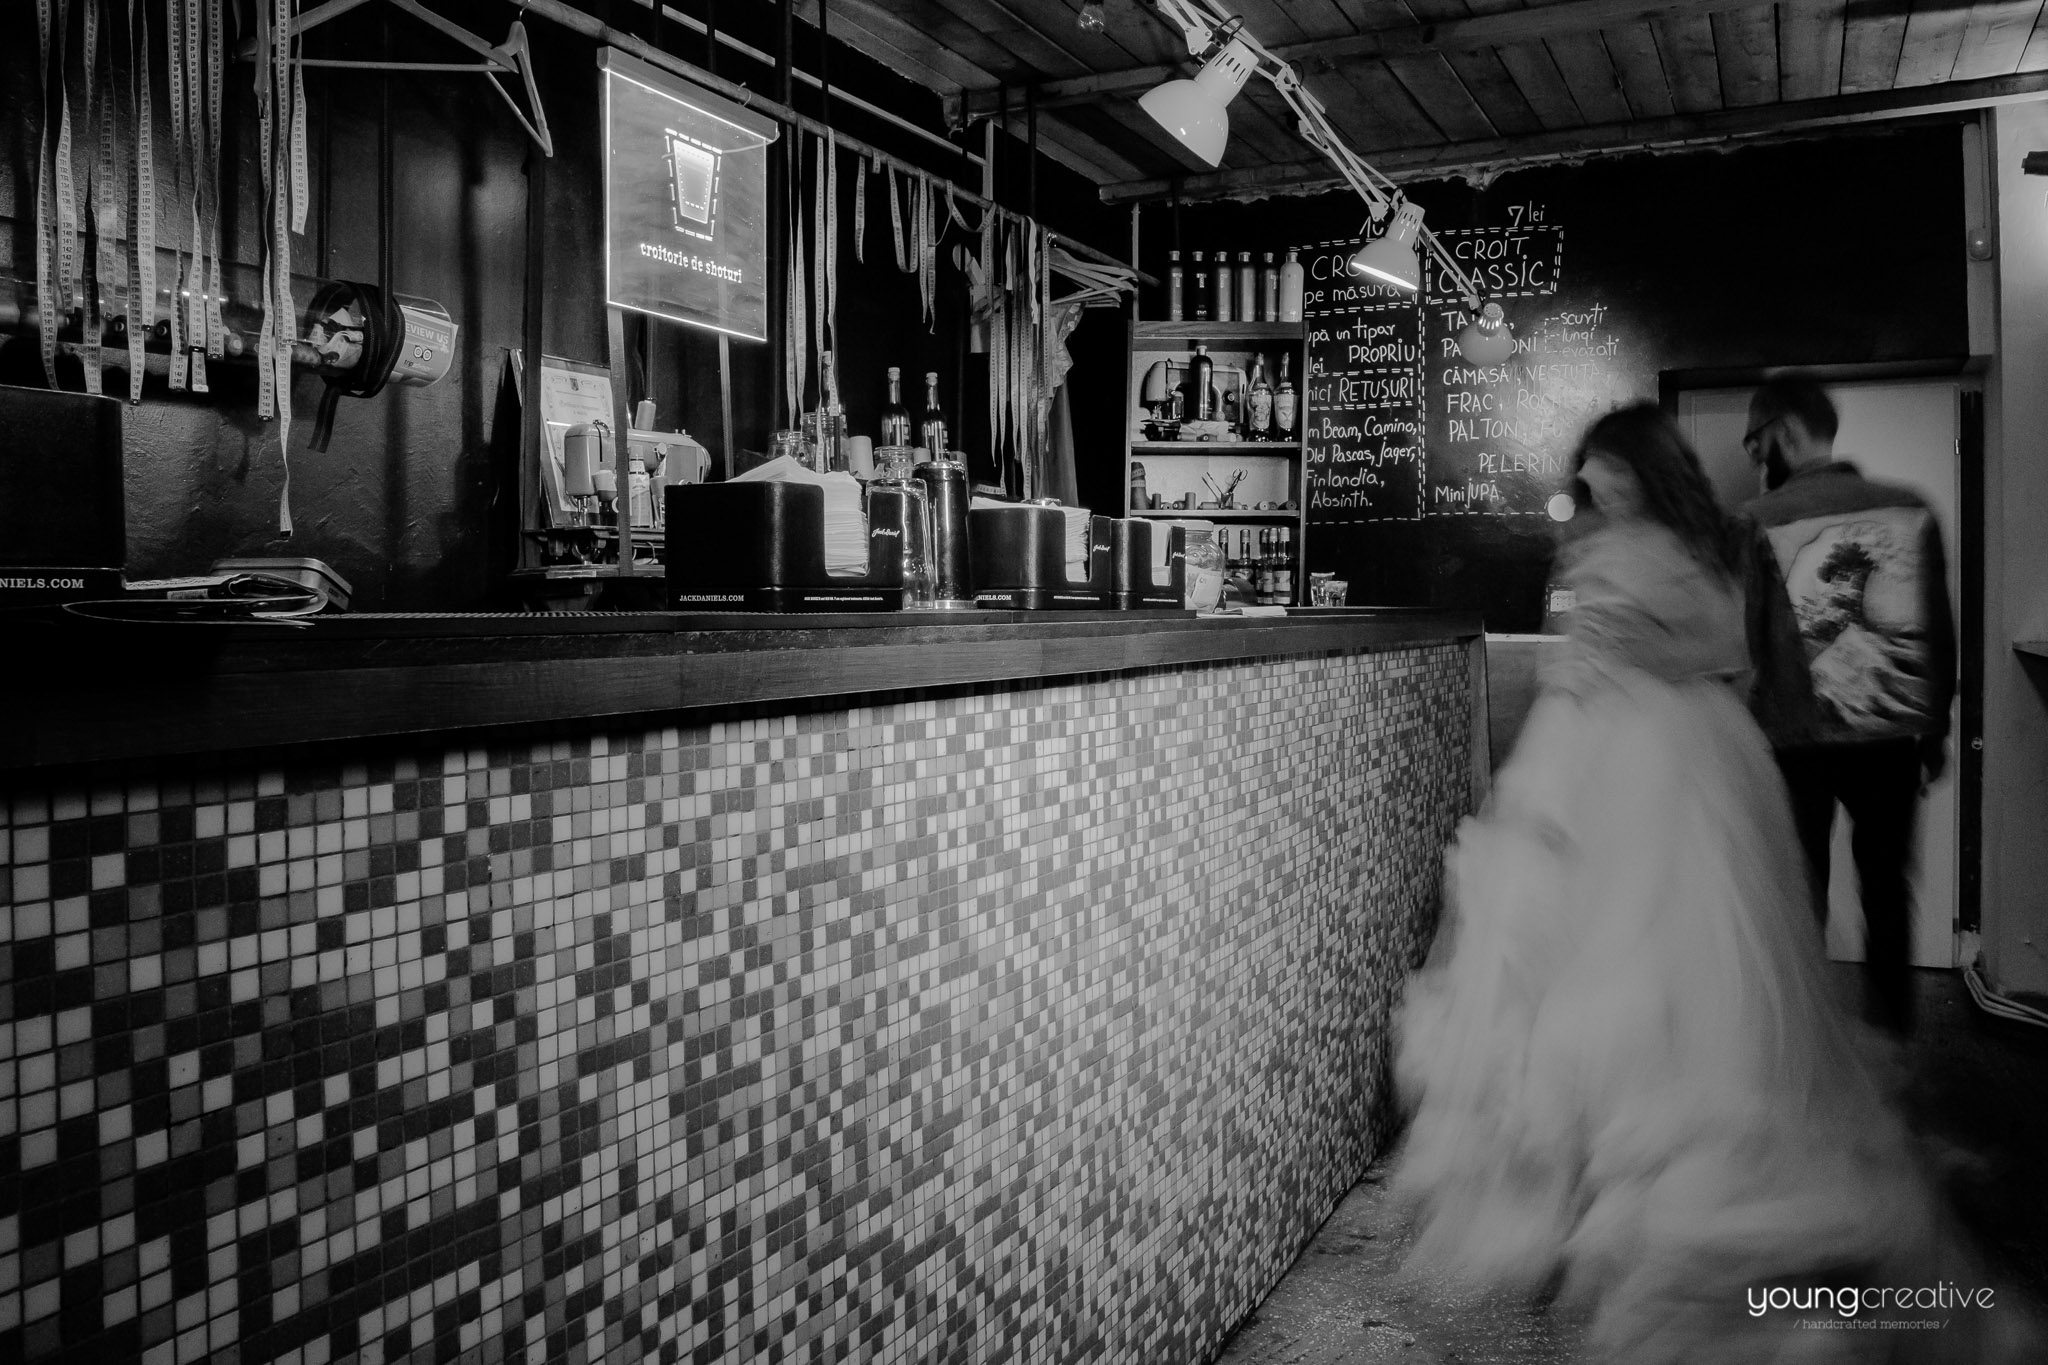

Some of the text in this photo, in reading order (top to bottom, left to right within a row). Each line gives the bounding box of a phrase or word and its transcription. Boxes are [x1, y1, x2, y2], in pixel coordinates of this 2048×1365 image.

[1507, 200, 1546, 227] 7 lei
[1455, 231, 1530, 260] CROIT
[640, 243, 742, 284] croitorie de shoturi
[1304, 291, 1325, 310] pe
[405, 322, 449, 345] EVIEW US
[1336, 330, 1351, 340] un
[1352, 316, 1396, 346] tipar
[1348, 338, 1416, 363] PROPRIU
[1309, 356, 1324, 374] lei
[1322, 417, 1362, 443] Beam,
[1364, 416, 1417, 436] Camino,
[1306, 467, 1385, 488] Finlandia,
[1311, 490, 1373, 509] Absinth.
